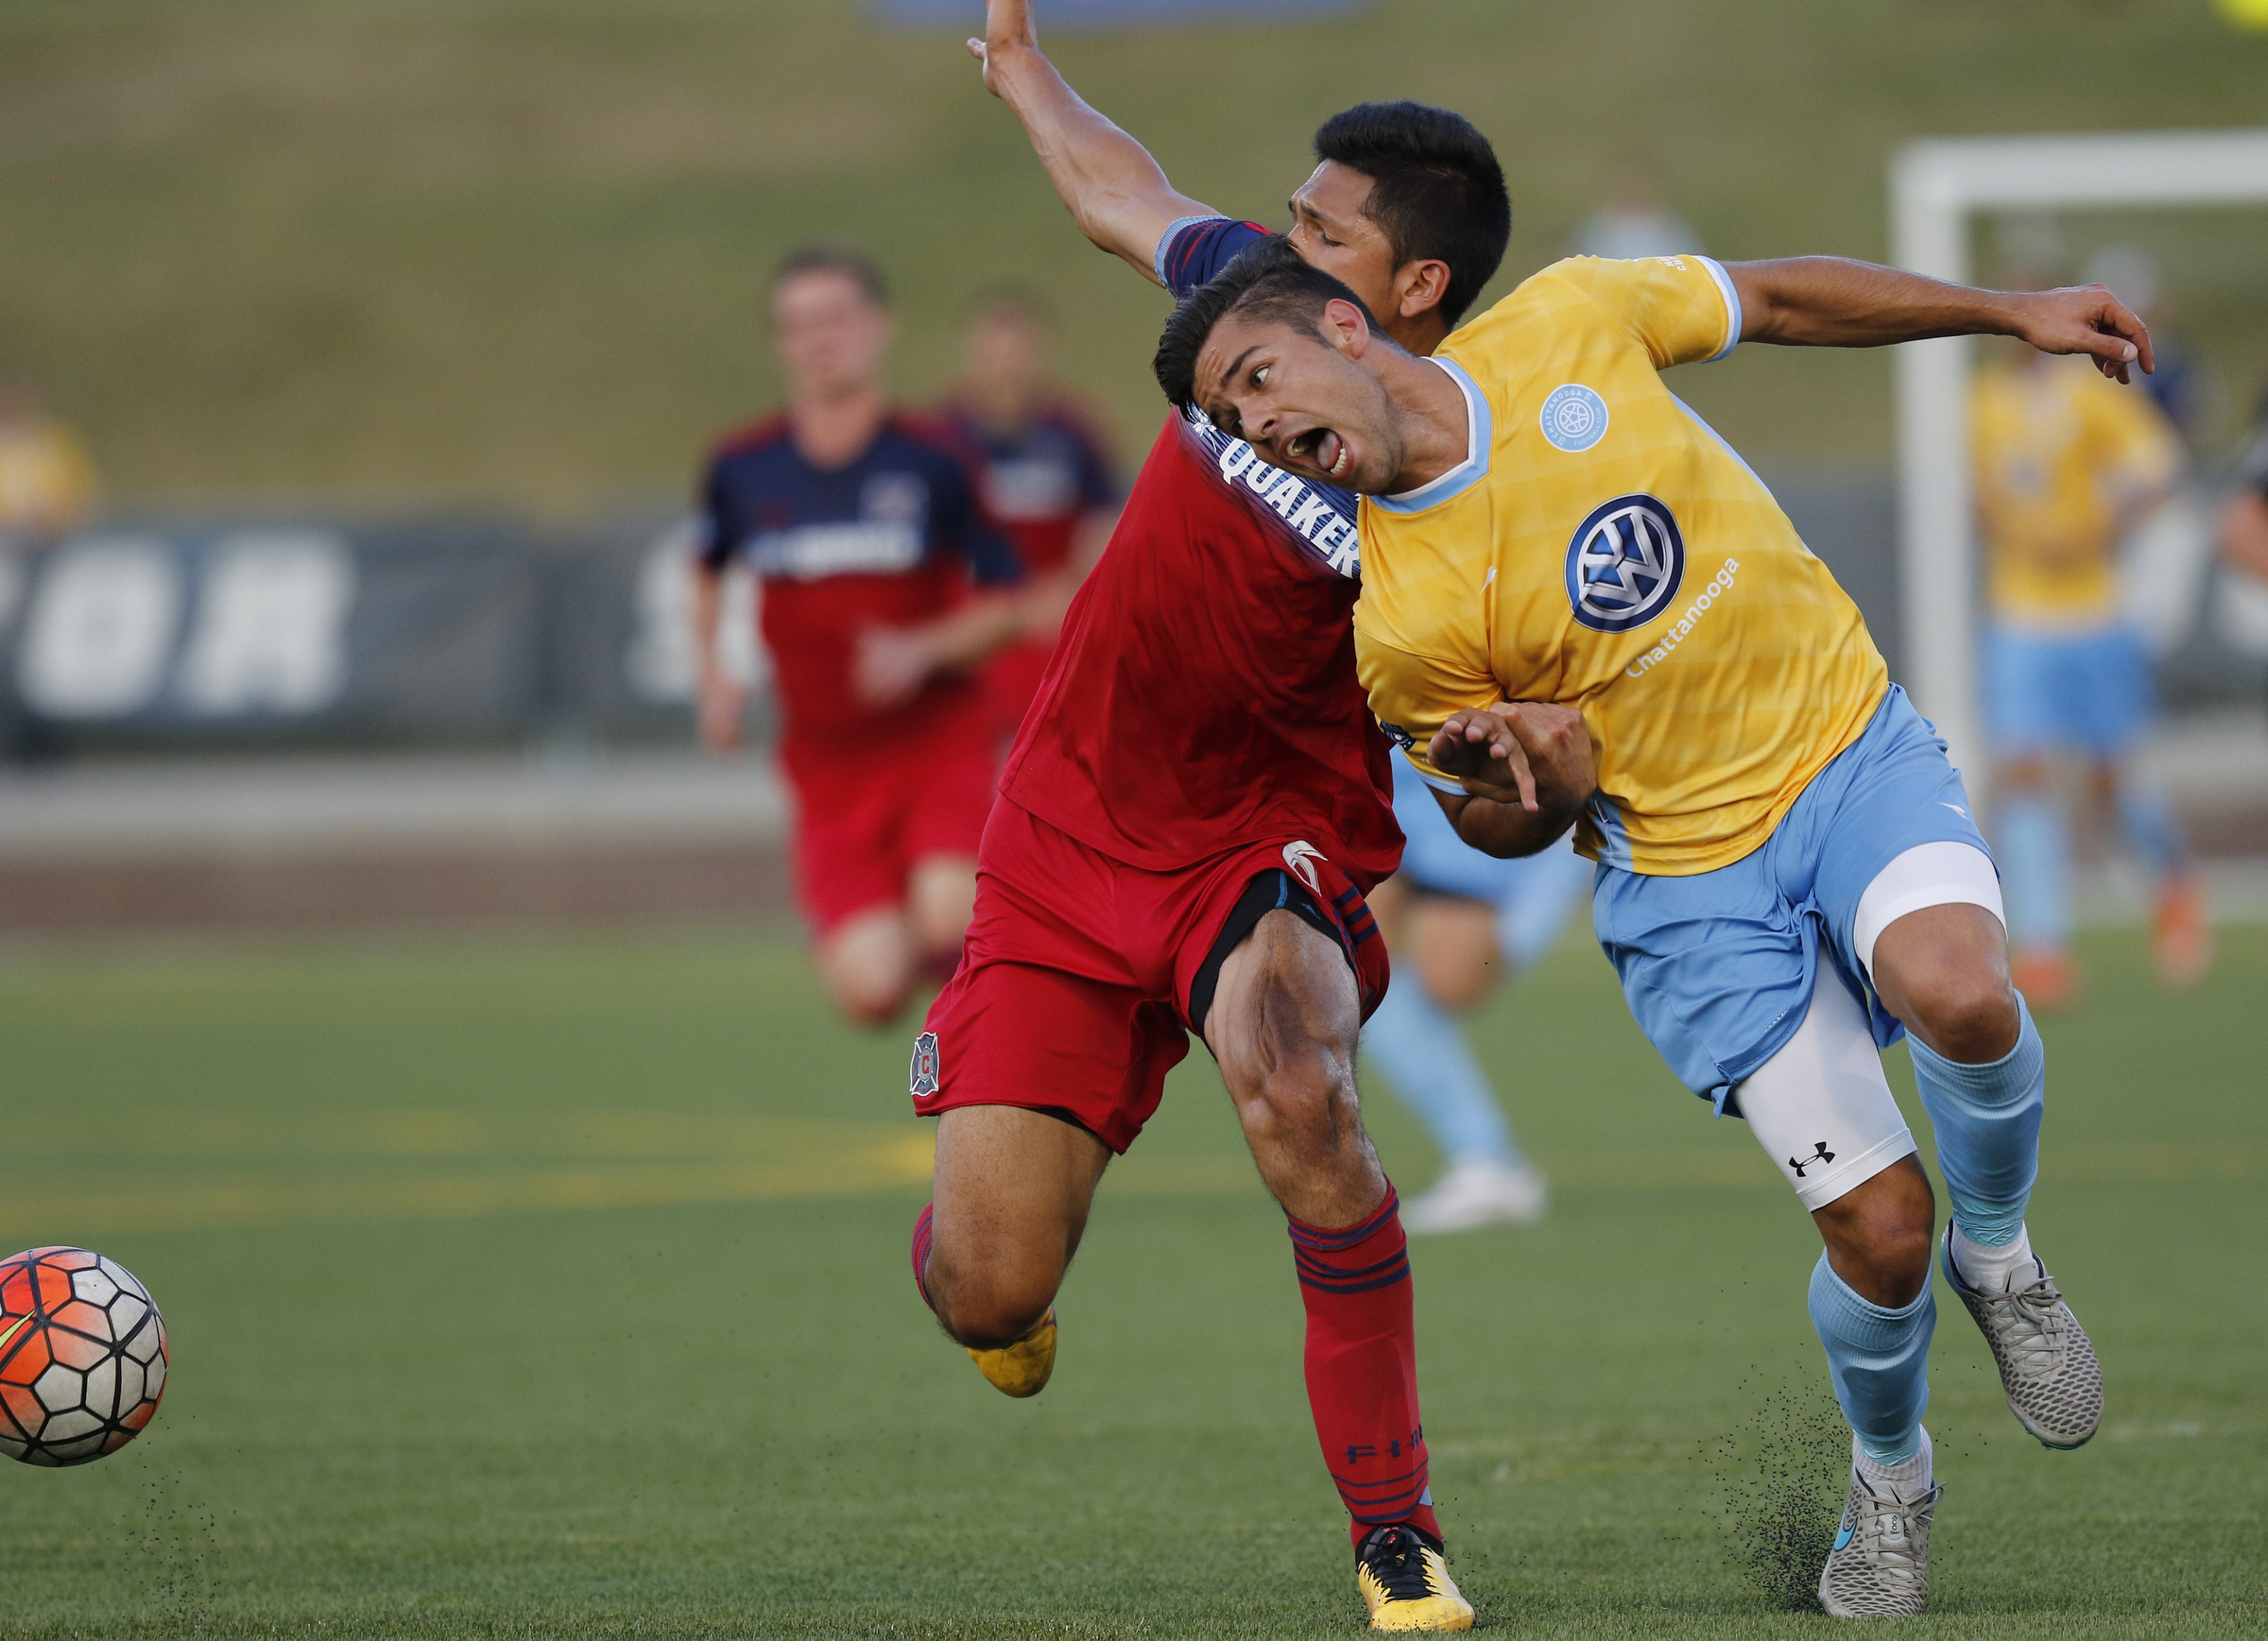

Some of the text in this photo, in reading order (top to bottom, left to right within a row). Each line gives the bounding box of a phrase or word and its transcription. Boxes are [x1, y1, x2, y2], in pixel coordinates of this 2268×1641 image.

[1545, 389, 1582, 438] CHATTANOOGA
[1573, 424, 1602, 446] FOOTBALL
[1218, 437, 1361, 579] QUAKER
[1624, 556, 1741, 678] Chattanooga
[922, 1054, 930, 1074] C
